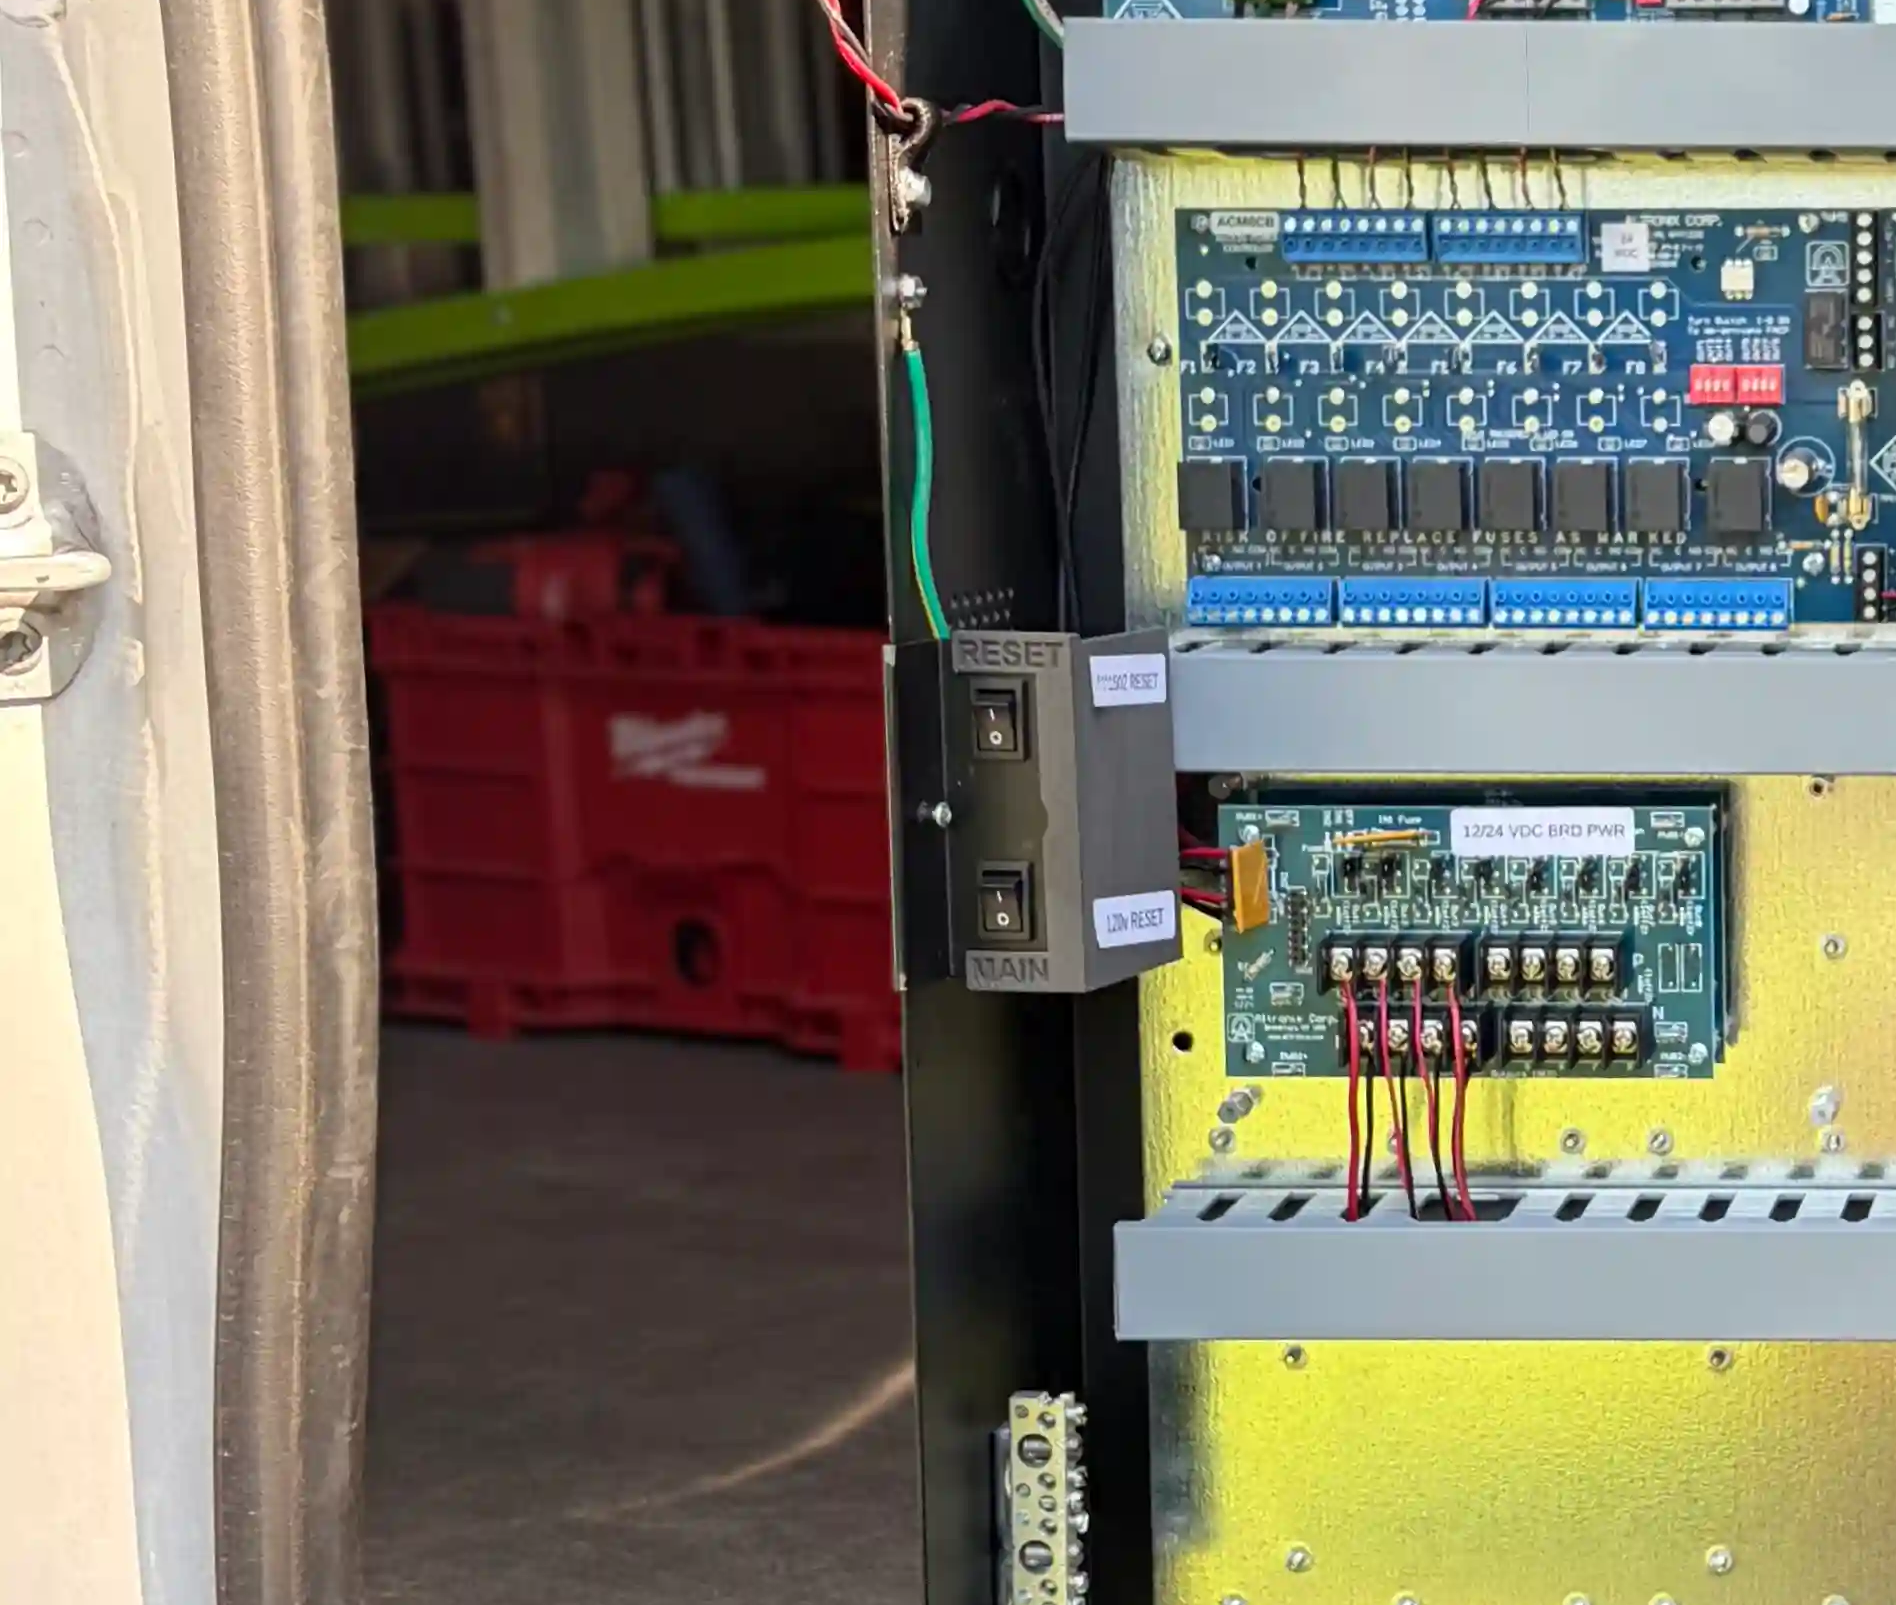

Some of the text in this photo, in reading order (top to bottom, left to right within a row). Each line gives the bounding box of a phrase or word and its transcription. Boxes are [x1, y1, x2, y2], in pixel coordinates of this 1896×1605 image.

[1202, 531, 1249, 544] RISK
[1300, 531, 1346, 544] FIRE
[1362, 531, 1457, 544] REPLACE
[1472, 531, 1538, 544] FUSES
[1555, 531, 1581, 544] AS
[957, 639, 1065, 668] RESET
[1129, 672, 1159, 690] RESET
[1463, 823, 1626, 838] 12/24 VDC BRD PWR
[1130, 907, 1164, 931] RESET
[970, 955, 1050, 988] MAIN
